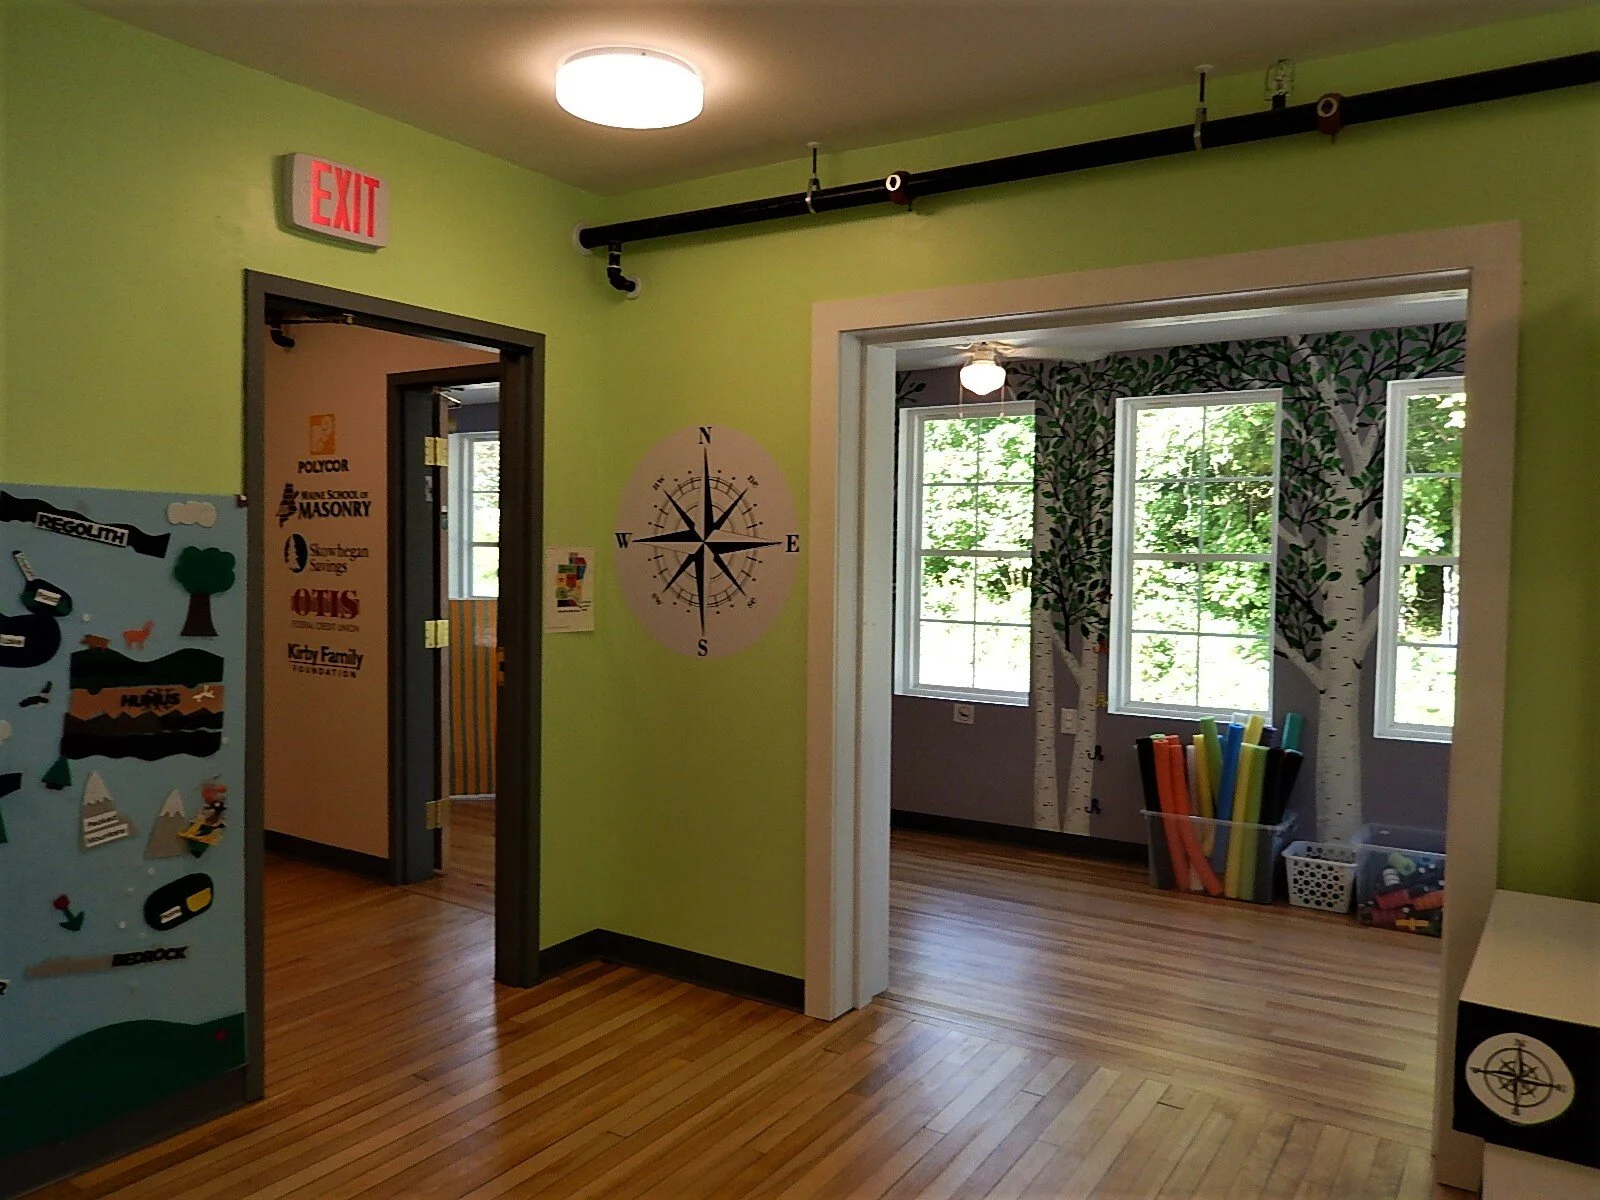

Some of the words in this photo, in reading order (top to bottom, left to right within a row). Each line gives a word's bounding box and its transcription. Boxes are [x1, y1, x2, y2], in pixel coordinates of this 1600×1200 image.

[311, 160, 380, 238] EXIT
[698, 426, 712, 444] N
[298, 459, 349, 474] POLYCOR
[298, 501, 371, 519] MASONRY
[38, 514, 125, 544] REGOLITH
[614, 532, 632, 549] W
[786, 534, 799, 553] E
[310, 543, 369, 561] Skowhegan
[310, 559, 347, 576] Savings
[291, 588, 360, 620] OTIS
[288, 643, 318, 665] Kirby
[321, 646, 364, 670] Family
[697, 639, 708, 656] S
[292, 665, 357, 679] FOUNDATION
[112, 946, 188, 967] BEDROCK
